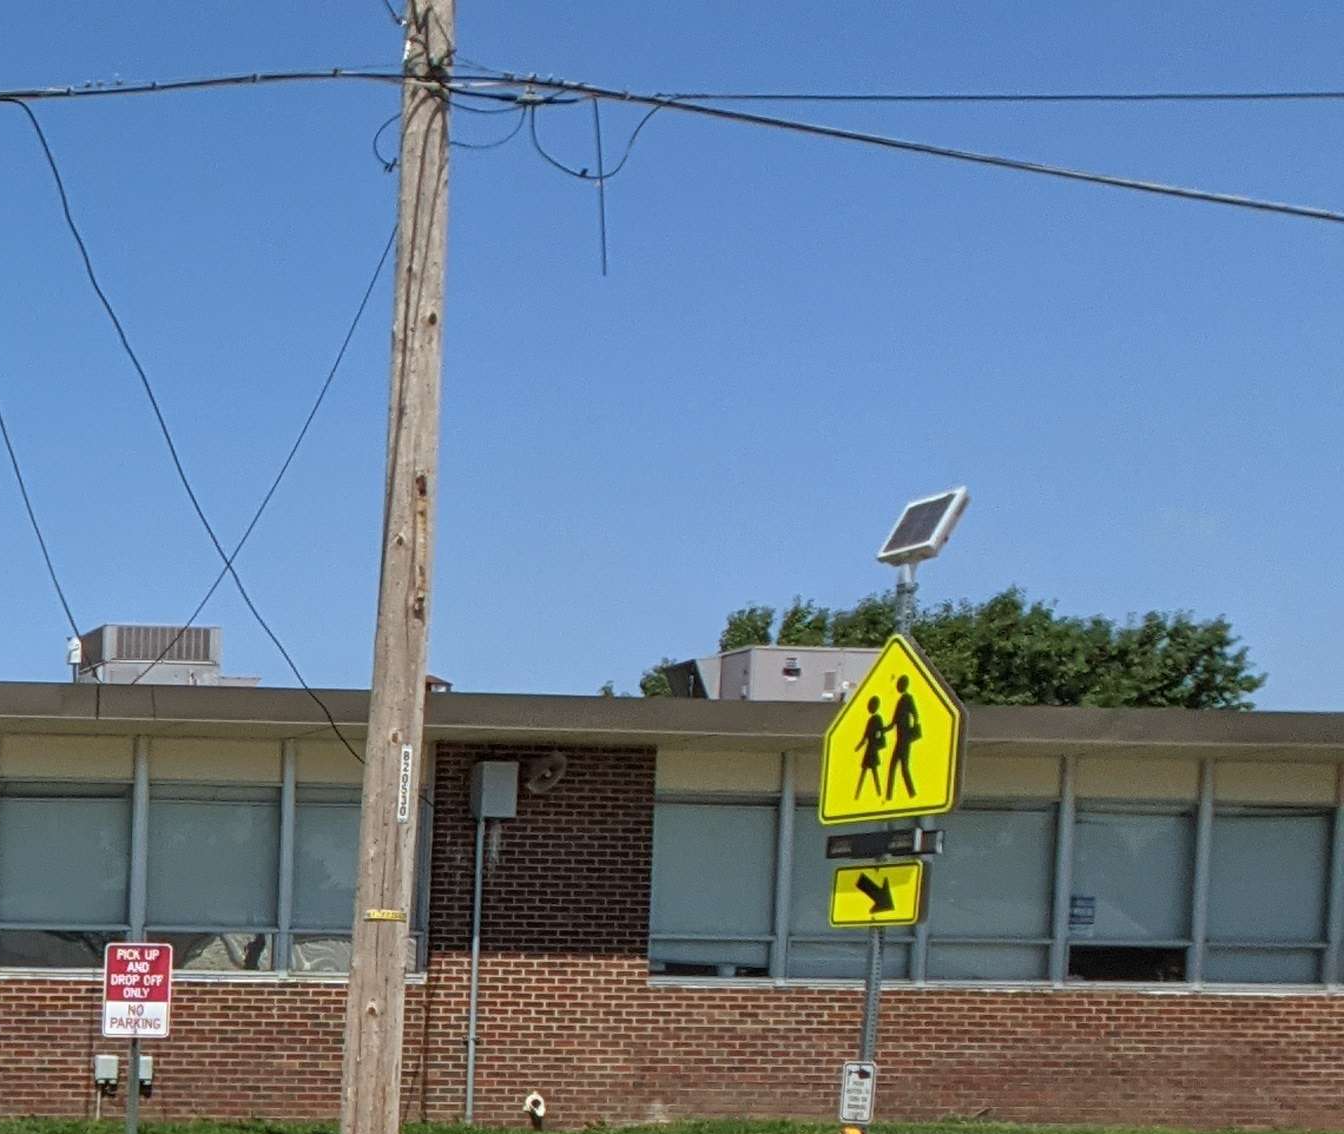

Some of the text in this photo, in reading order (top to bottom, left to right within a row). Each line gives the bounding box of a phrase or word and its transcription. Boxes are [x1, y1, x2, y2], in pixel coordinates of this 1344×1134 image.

[116, 948, 160, 960] PICK UP
[126, 961, 150, 973] AND
[111, 973, 164, 986] DROP OFF
[123, 987, 150, 998] ONLY
[127, 1003, 144, 1016] NO
[109, 1017, 161, 1030] PARKING
